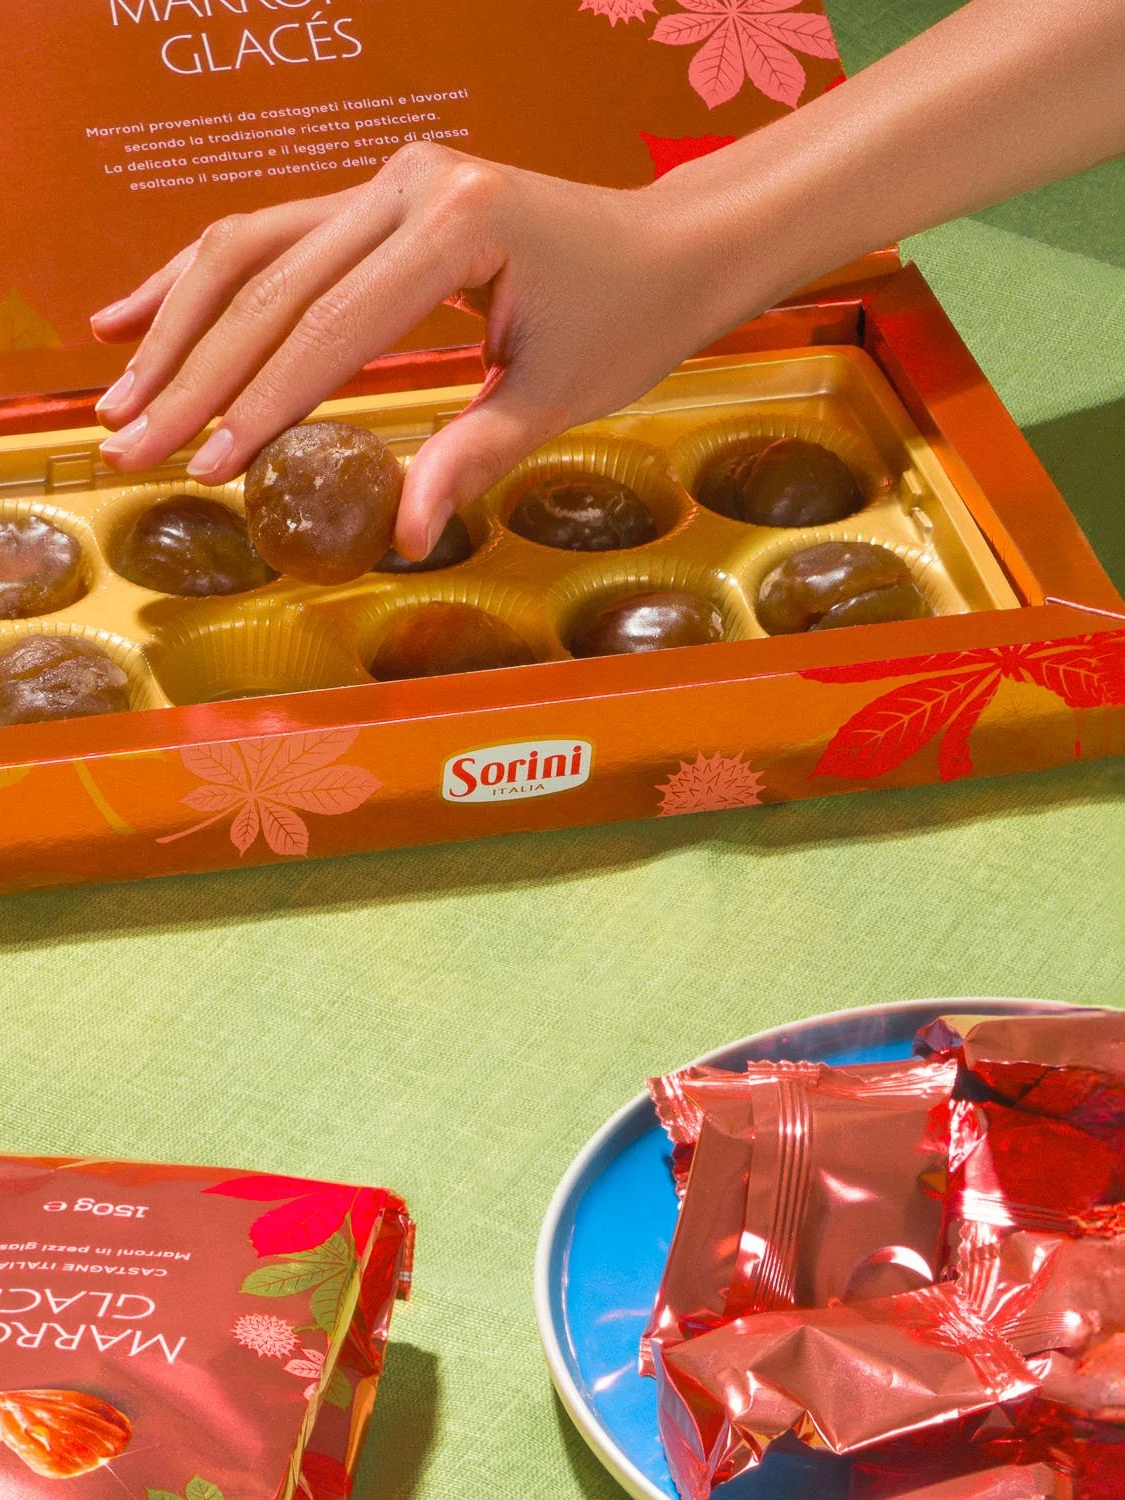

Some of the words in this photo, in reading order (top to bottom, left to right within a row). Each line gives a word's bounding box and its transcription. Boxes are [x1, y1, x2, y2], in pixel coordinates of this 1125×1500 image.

[161, 11, 363, 75] GLACÉS
[86, 122, 144, 137] Marroni
[149, 113, 233, 133] provenienti
[238, 111, 256, 122] da
[261, 102, 339, 120] castagneti
[343, 96, 394, 111] italiani
[398, 95, 407, 105] e
[411, 89, 469, 104] lavorati
[124, 138, 185, 153] secondo
[190, 135, 203, 146] la
[208, 125, 296, 144] tradizionale
[300, 119, 350, 134] ricetta
[355, 112, 440, 130] pasticciera.
[104, 163, 123, 174] La
[128, 156, 188, 172] delicata
[192, 148, 263, 164] canditura
[268, 147, 277, 157] e
[281, 145, 289, 156] il
[294, 140, 349, 155] leggero
[354, 133, 399, 148] strato
[404, 131, 417, 142] di
[422, 127, 469, 142] glassa
[130, 173, 194, 191] esaltano
[198, 173, 207, 184] il
[211, 168, 263, 183] sapore
[268, 160, 337, 176] autentico
[342, 155, 377, 168] delle
[449, 745, 582, 797] Sorini
[492, 783, 545, 796] ITALIA
[73, 1197, 150, 1219] 150g
[42, 1244, 90, 1255] pezzi
[95, 1248, 111, 1256] in
[116, 1249, 191, 1261] Marroni
[62, 1263, 168, 1277] CASTAGNE
